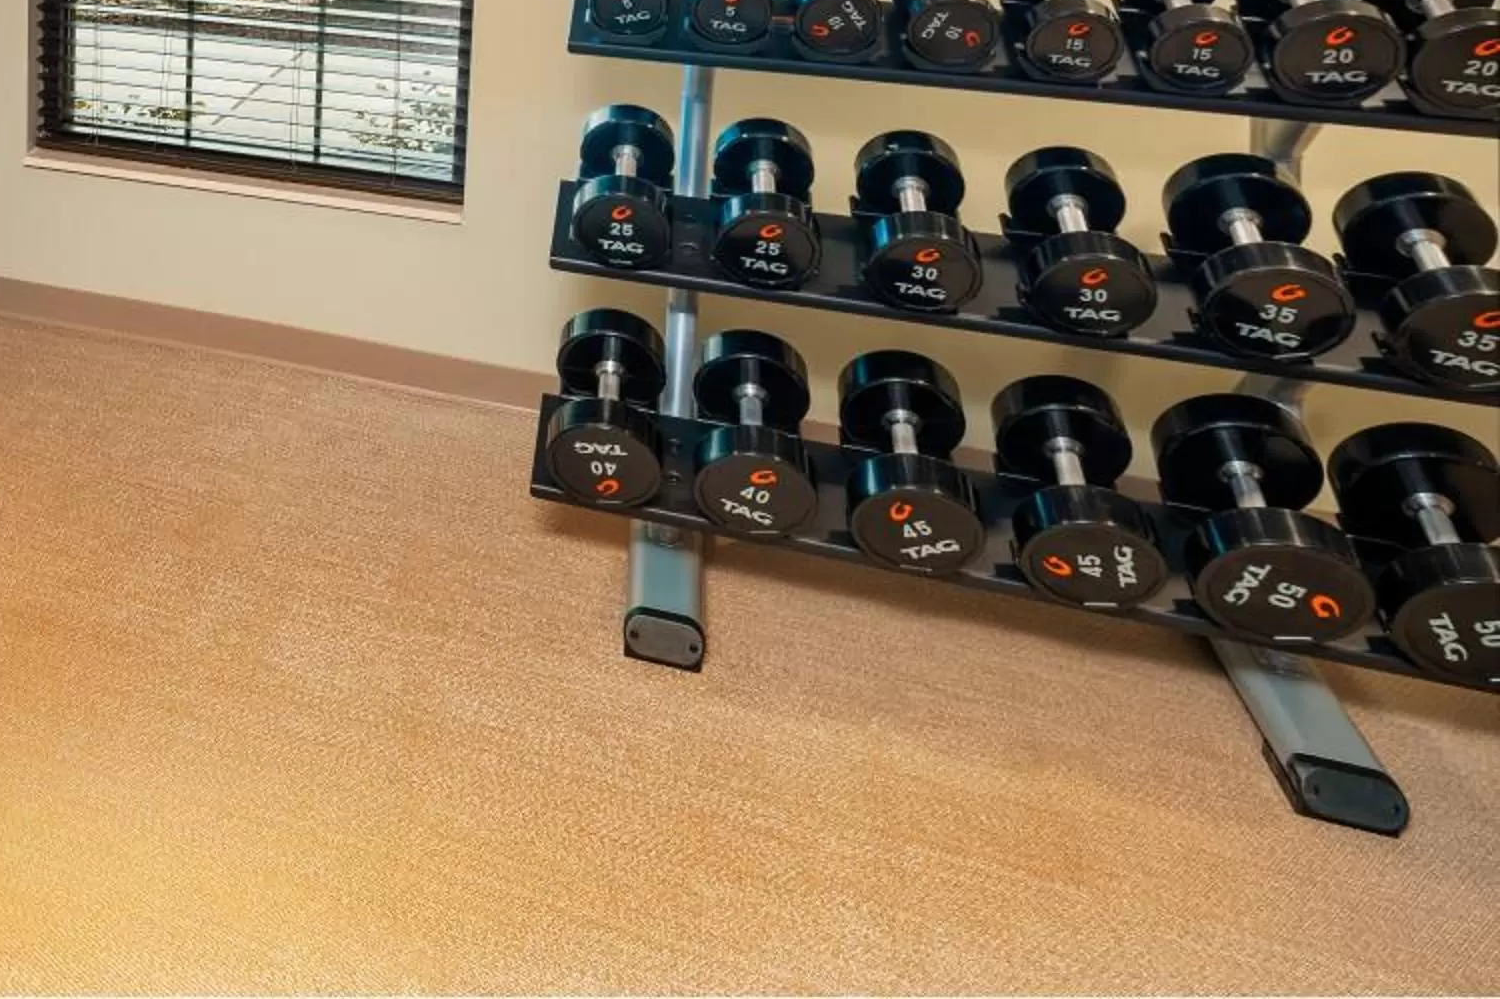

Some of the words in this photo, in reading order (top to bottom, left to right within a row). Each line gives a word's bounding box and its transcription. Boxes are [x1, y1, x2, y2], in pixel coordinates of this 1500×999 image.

[614, 8, 650, 23] TAG
[726, 6, 736, 16] 5
[838, 1, 866, 29] TAG
[710, 20, 746, 31] TAG
[922, 12, 950, 38] TAG
[1067, 39, 1083, 50] 15
[1048, 54, 1091, 67] TAG
[1193, 49, 1212, 60] 15
[1322, 49, 1353, 63] 20
[1174, 64, 1219, 77] TAG
[1464, 60, 1498, 76] 20
[1305, 71, 1367, 83] TAG
[1442, 81, 1500, 97] TAG
[610, 223, 633, 236] 25
[598, 239, 643, 253] TAG
[756, 241, 781, 255] 25
[741, 257, 787, 274] TAG
[912, 265, 938, 281] 30
[895, 280, 946, 300] TAG
[1080, 289, 1107, 302] 30
[1064, 307, 1120, 321] TAG
[1260, 304, 1297, 323] 35
[1236, 321, 1300, 347] TAG
[1457, 331, 1500, 351] 35
[1430, 348, 1500, 376] TAG
[574, 442, 628, 455] TAG
[591, 461, 616, 475] 40
[738, 487, 769, 506] 40
[721, 497, 772, 525] TAG
[904, 521, 932, 537] 45
[900, 540, 960, 559] TAG
[1077, 555, 1102, 577] 45
[1115, 547, 1136, 587] TAG
[1224, 565, 1274, 604] TAG
[1269, 583, 1306, 608] 50
[1429, 613, 1467, 661] TAG
[1474, 621, 1500, 647] 50
